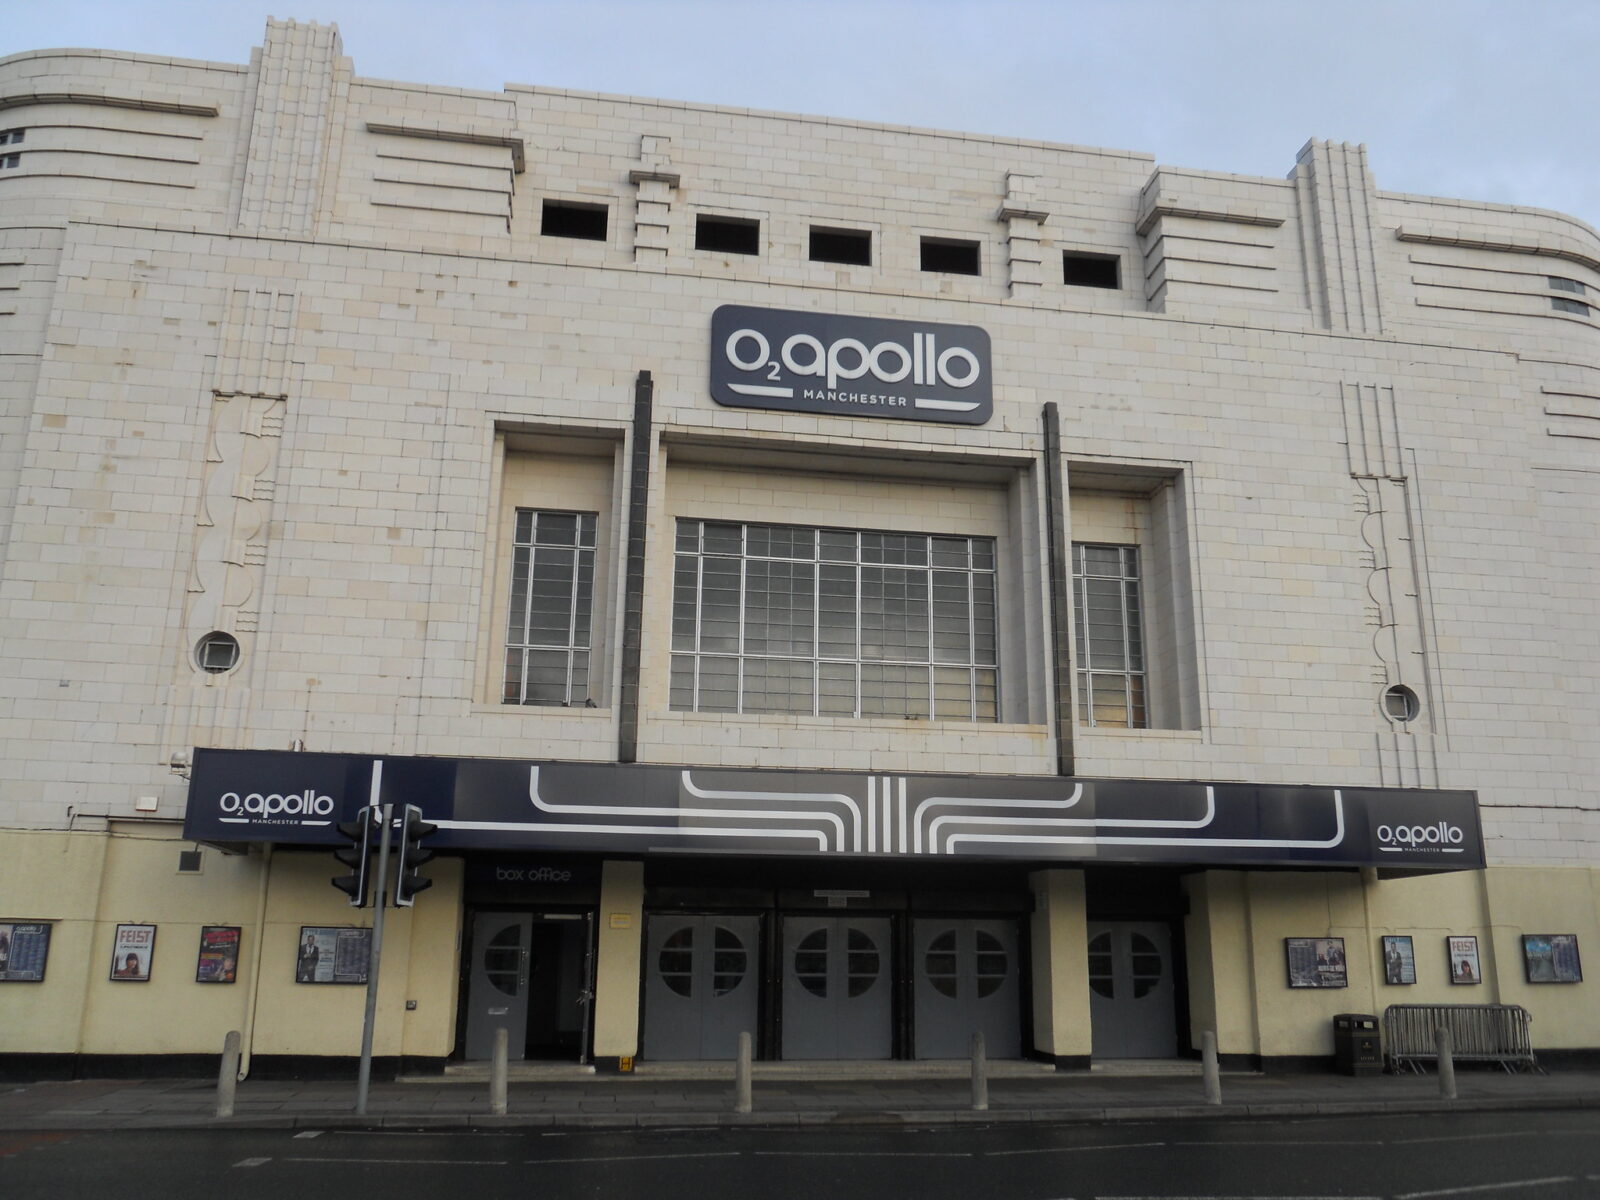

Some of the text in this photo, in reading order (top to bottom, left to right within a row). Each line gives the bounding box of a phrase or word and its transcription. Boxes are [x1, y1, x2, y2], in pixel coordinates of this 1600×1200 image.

[803, 389, 907, 407] MANCHESTER
[496, 866, 572, 882] box office
[120, 930, 152, 943] FEIST
[1451, 940, 1475, 951] FEIST
